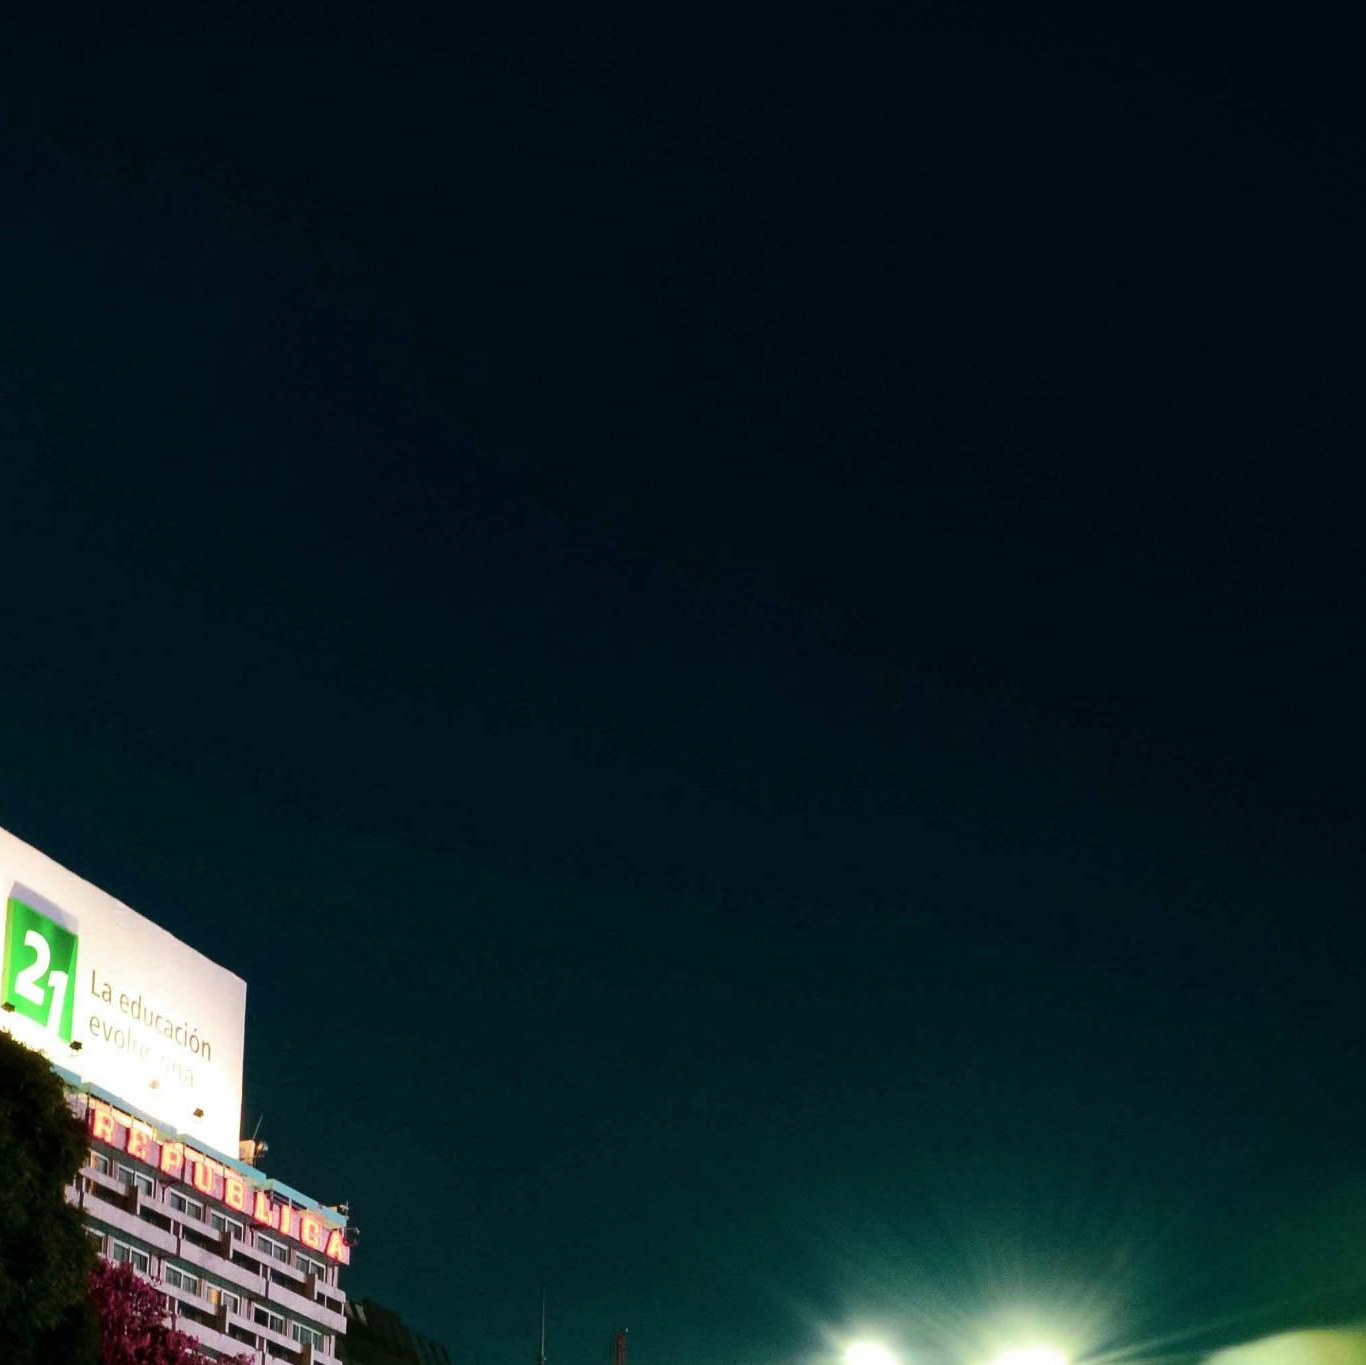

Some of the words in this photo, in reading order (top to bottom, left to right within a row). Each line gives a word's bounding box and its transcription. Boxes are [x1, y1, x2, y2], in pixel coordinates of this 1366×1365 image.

[14, 929, 69, 1038] 21
[91, 969, 113, 1004] La
[119, 994, 211, 1061] educación
[89, 1107, 346, 1264] REPUBLICA
